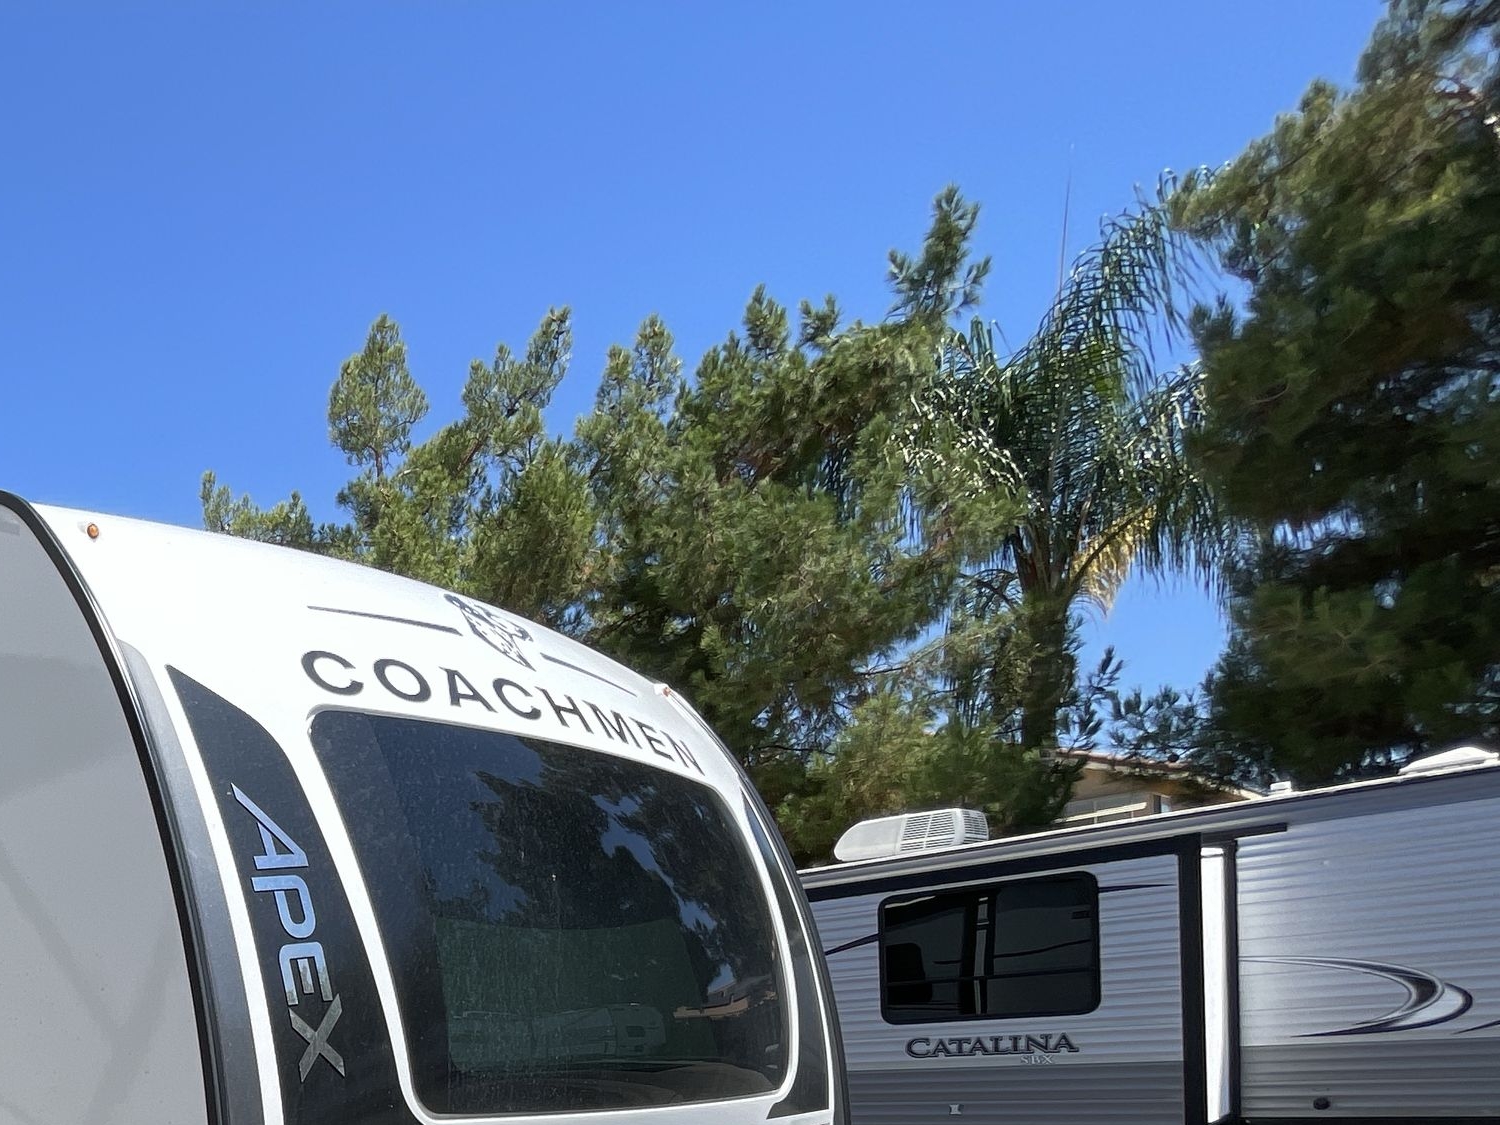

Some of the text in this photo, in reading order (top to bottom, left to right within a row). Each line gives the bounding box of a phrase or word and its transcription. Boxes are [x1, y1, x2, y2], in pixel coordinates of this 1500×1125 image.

[301, 650, 705, 776] COACHMEN
[231, 782, 345, 1082] APEX
[905, 1032, 1080, 1058] CATALINA
